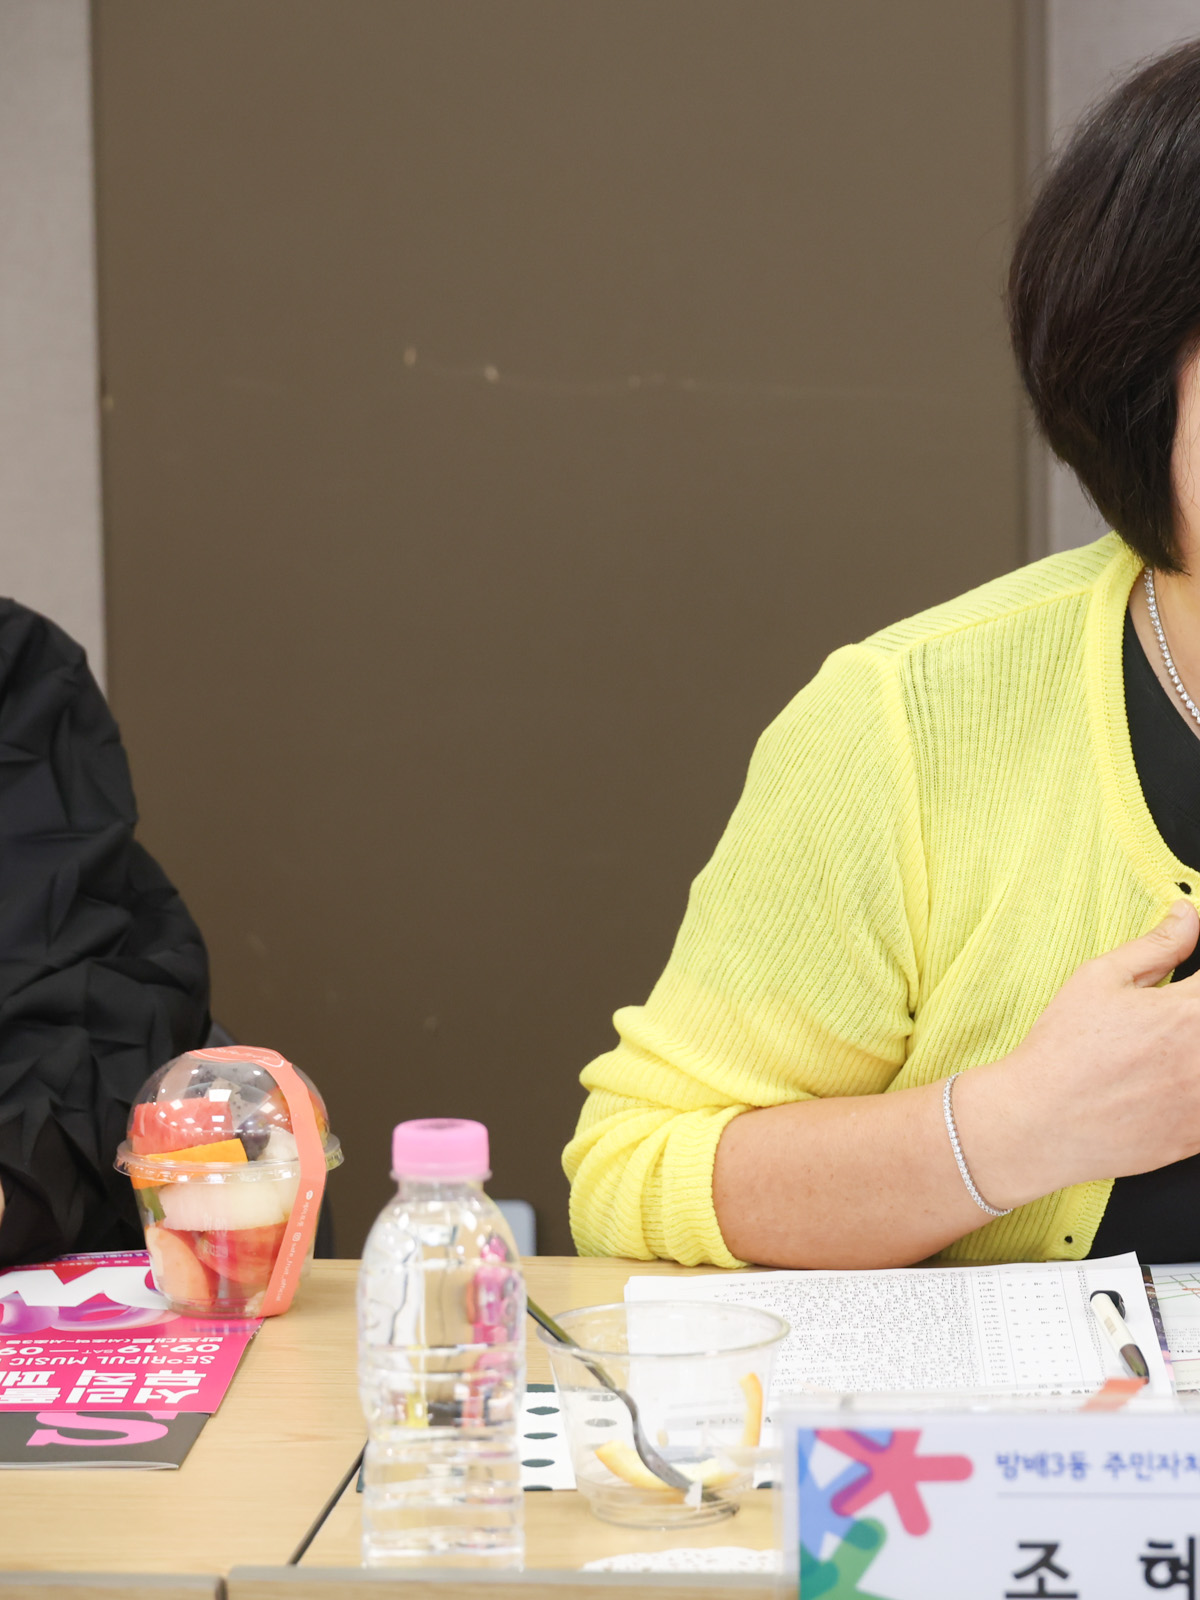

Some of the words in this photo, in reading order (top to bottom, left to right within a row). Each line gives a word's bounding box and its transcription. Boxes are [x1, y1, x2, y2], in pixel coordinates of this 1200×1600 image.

[117, 1343, 220, 1354] 09.19
[9, 1356, 88, 1366] MUSIC
[75, 1369, 206, 1386] 뮤직
[0, 1387, 200, 1404] 서리풀
[995, 1449, 1090, 1482] 방배3동
[1004, 1538, 1080, 1600] 조
